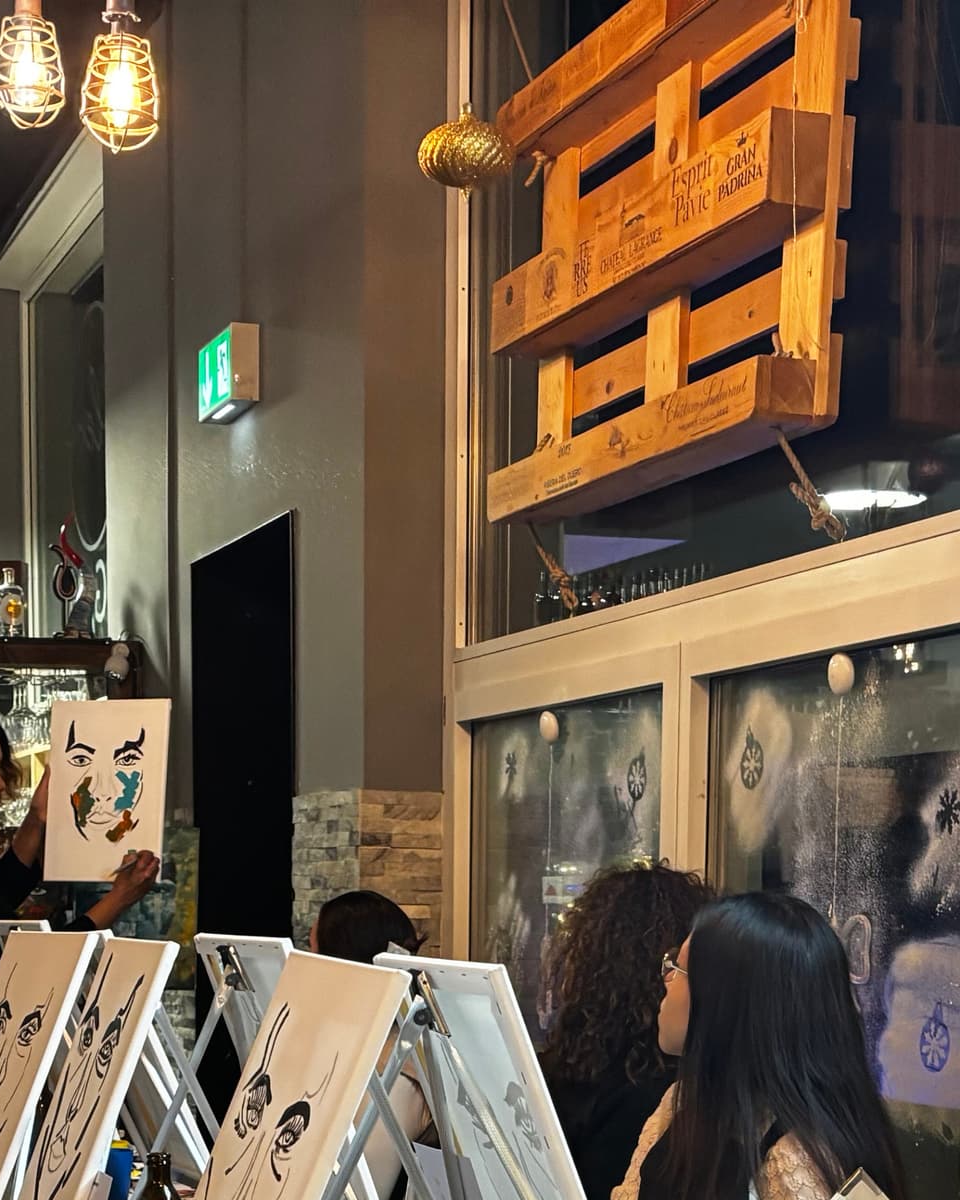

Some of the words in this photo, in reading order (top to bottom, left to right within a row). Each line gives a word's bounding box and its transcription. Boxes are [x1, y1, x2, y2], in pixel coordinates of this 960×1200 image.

[671, 150, 714, 199] Esprit
[726, 143, 757, 175] GRAN
[717, 162, 763, 202] PADRINA
[673, 186, 711, 227] Pavie
